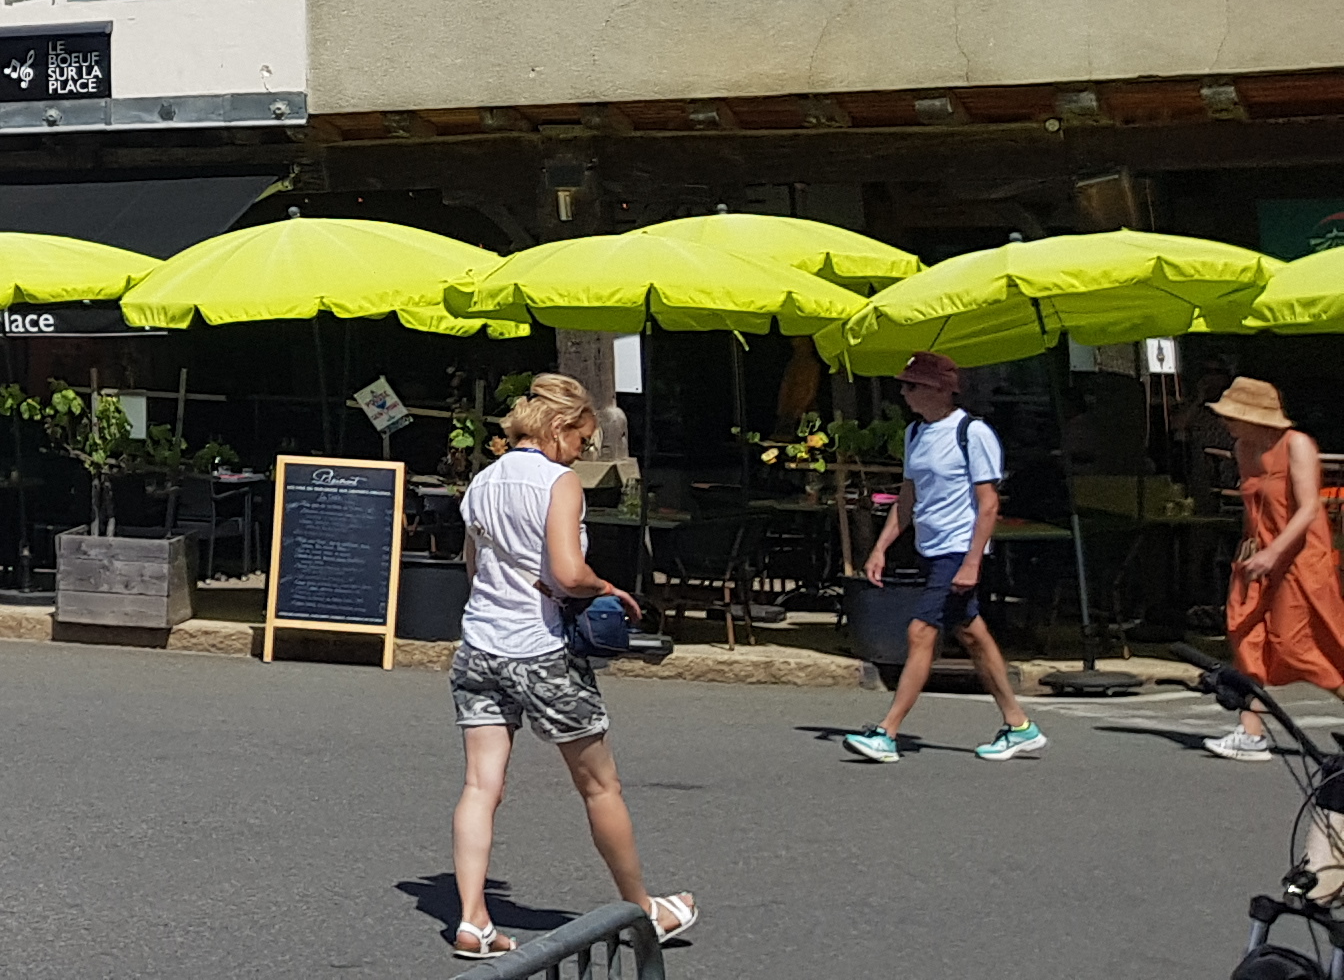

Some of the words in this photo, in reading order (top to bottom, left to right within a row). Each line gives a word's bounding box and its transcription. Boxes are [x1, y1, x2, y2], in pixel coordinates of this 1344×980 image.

[48, 40, 65, 54] LE
[48, 52, 100, 68] BOEUF
[48, 66, 78, 81] SUR
[82, 66, 102, 79] LA
[48, 79, 97, 94] PLACE
